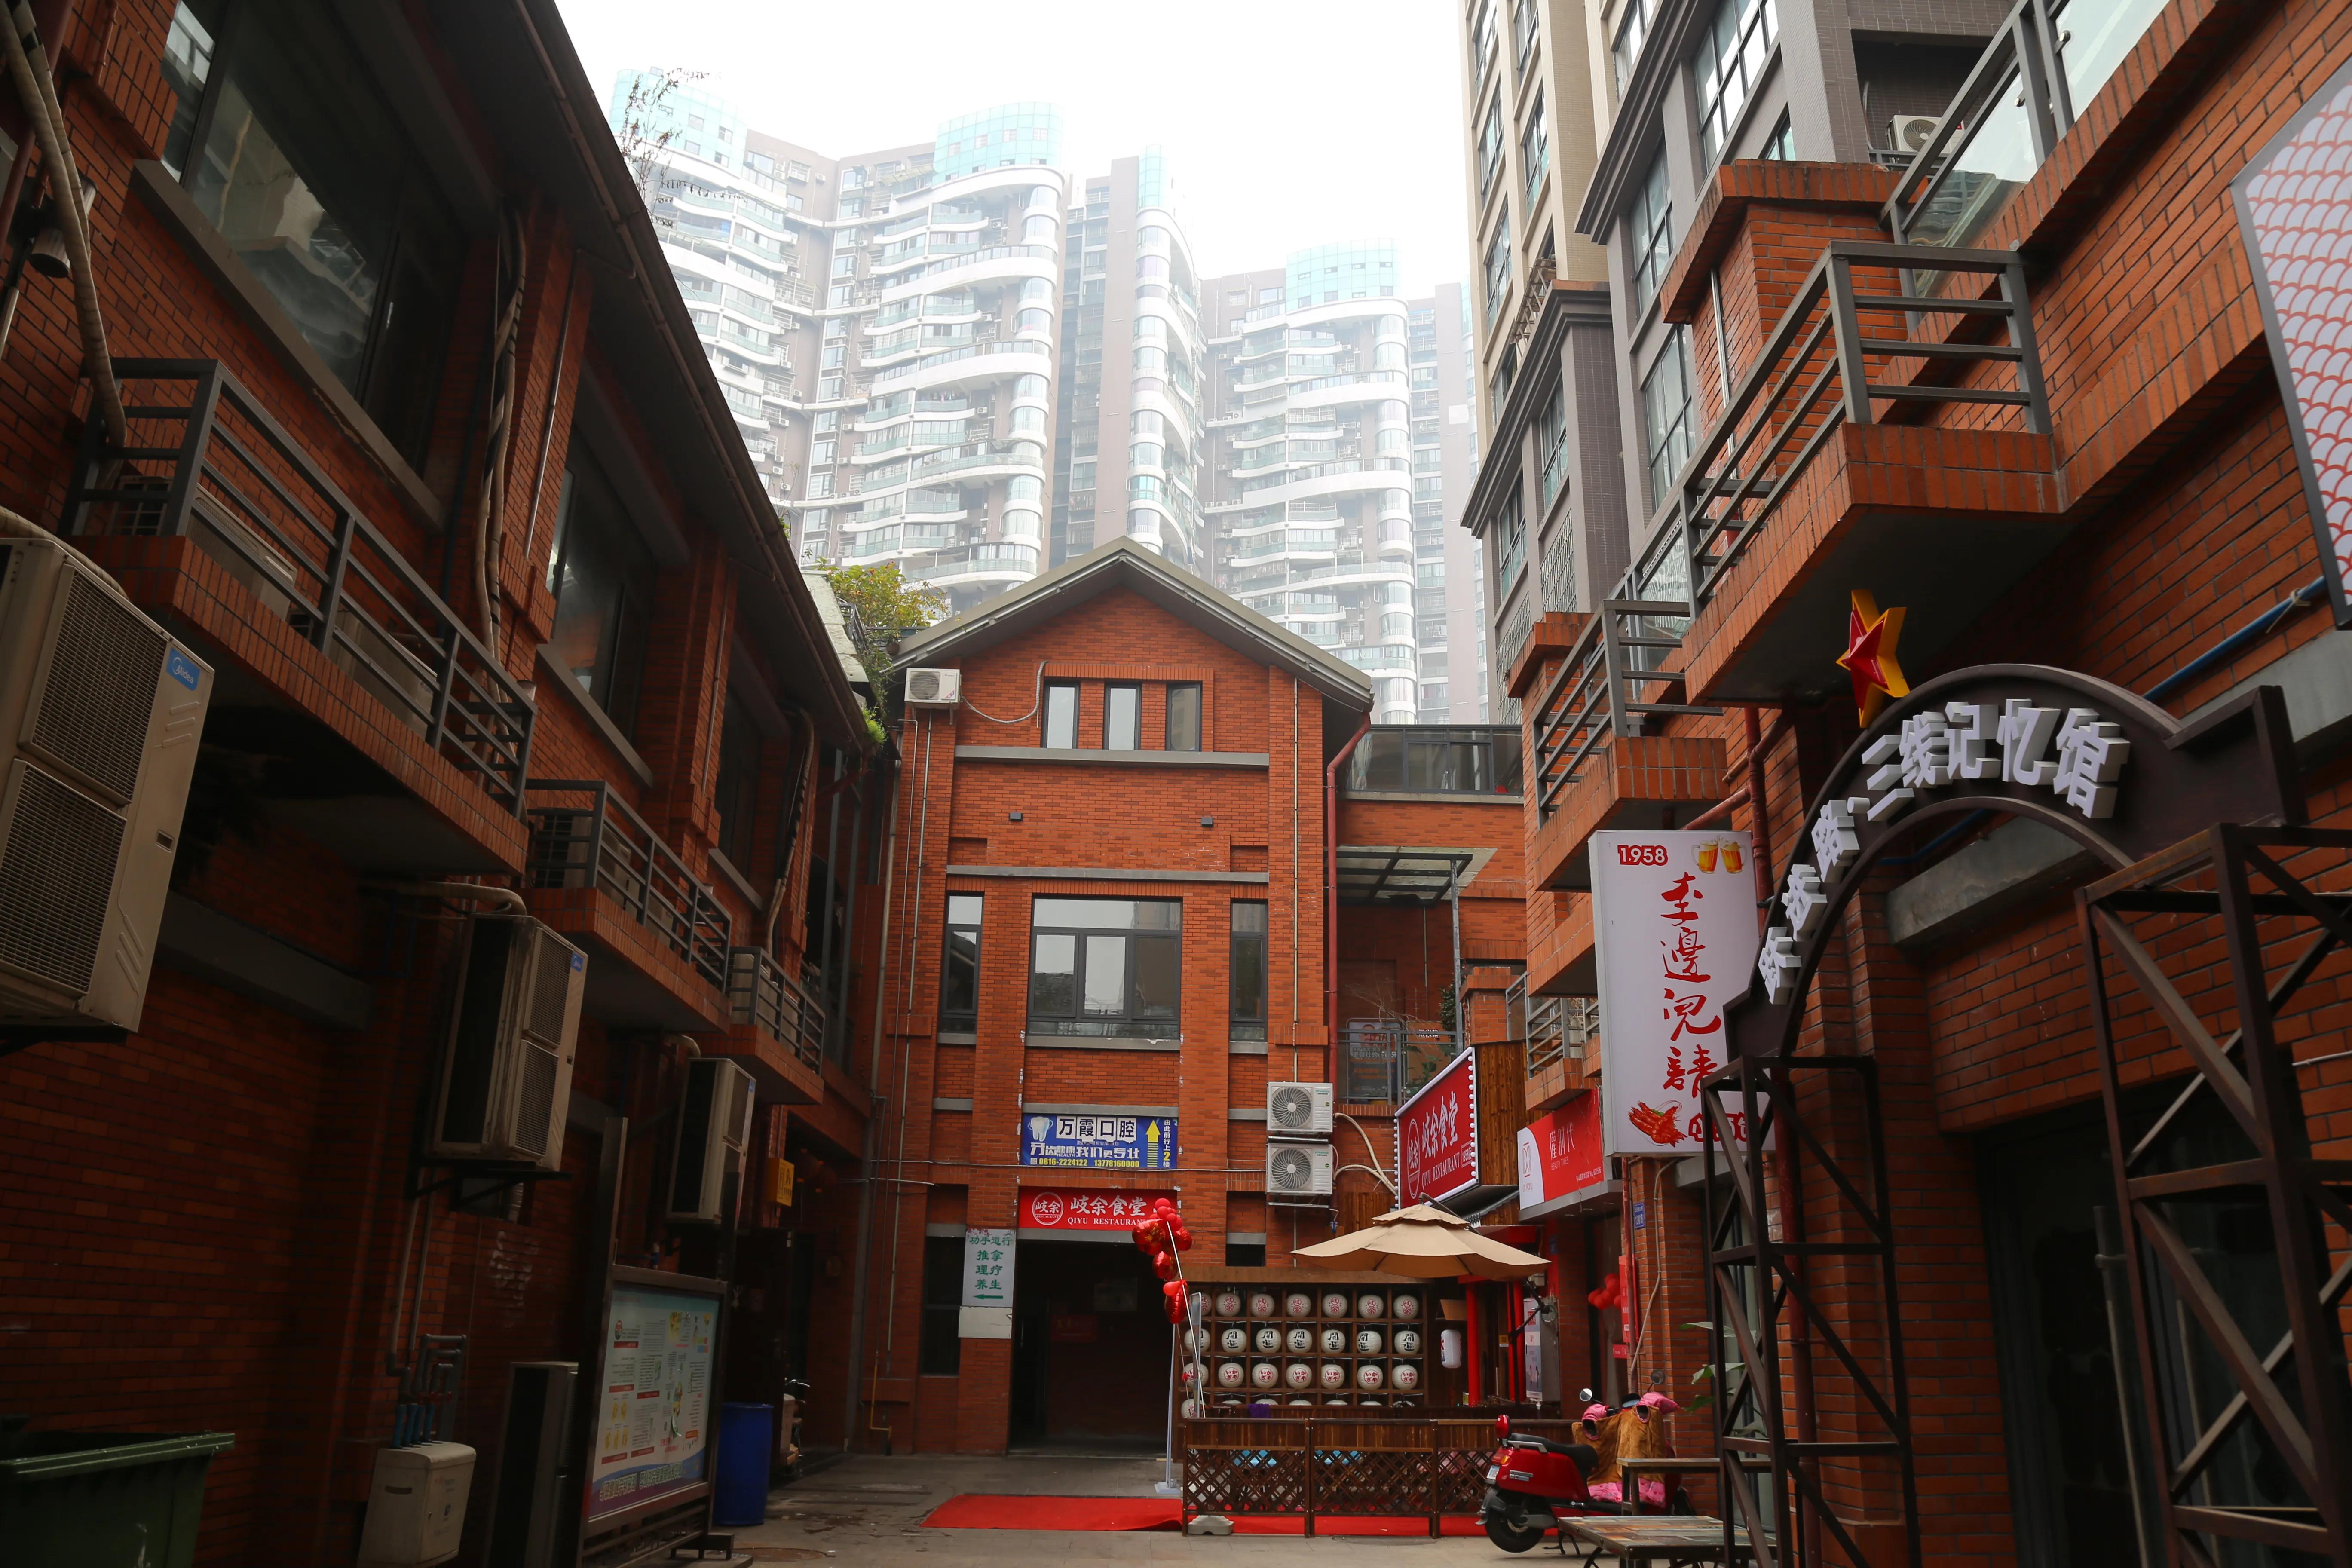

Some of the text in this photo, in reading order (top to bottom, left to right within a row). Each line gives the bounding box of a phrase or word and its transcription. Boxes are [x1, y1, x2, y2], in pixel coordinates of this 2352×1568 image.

[1619, 846, 1666, 864] 1958
[1059, 1118, 1135, 1138] 万霞口腔
[1039, 1158, 1139, 1168] 0816-2224122 13778160000
[1422, 1152, 1460, 1190] QIYU RESTAURANT
[1067, 1217, 1147, 1226] QIYU RESTAURAN
[976, 1250, 1004, 1261] 推拿
[975, 1265, 1003, 1276] 理疗
[974, 1279, 1002, 1290] 养生
